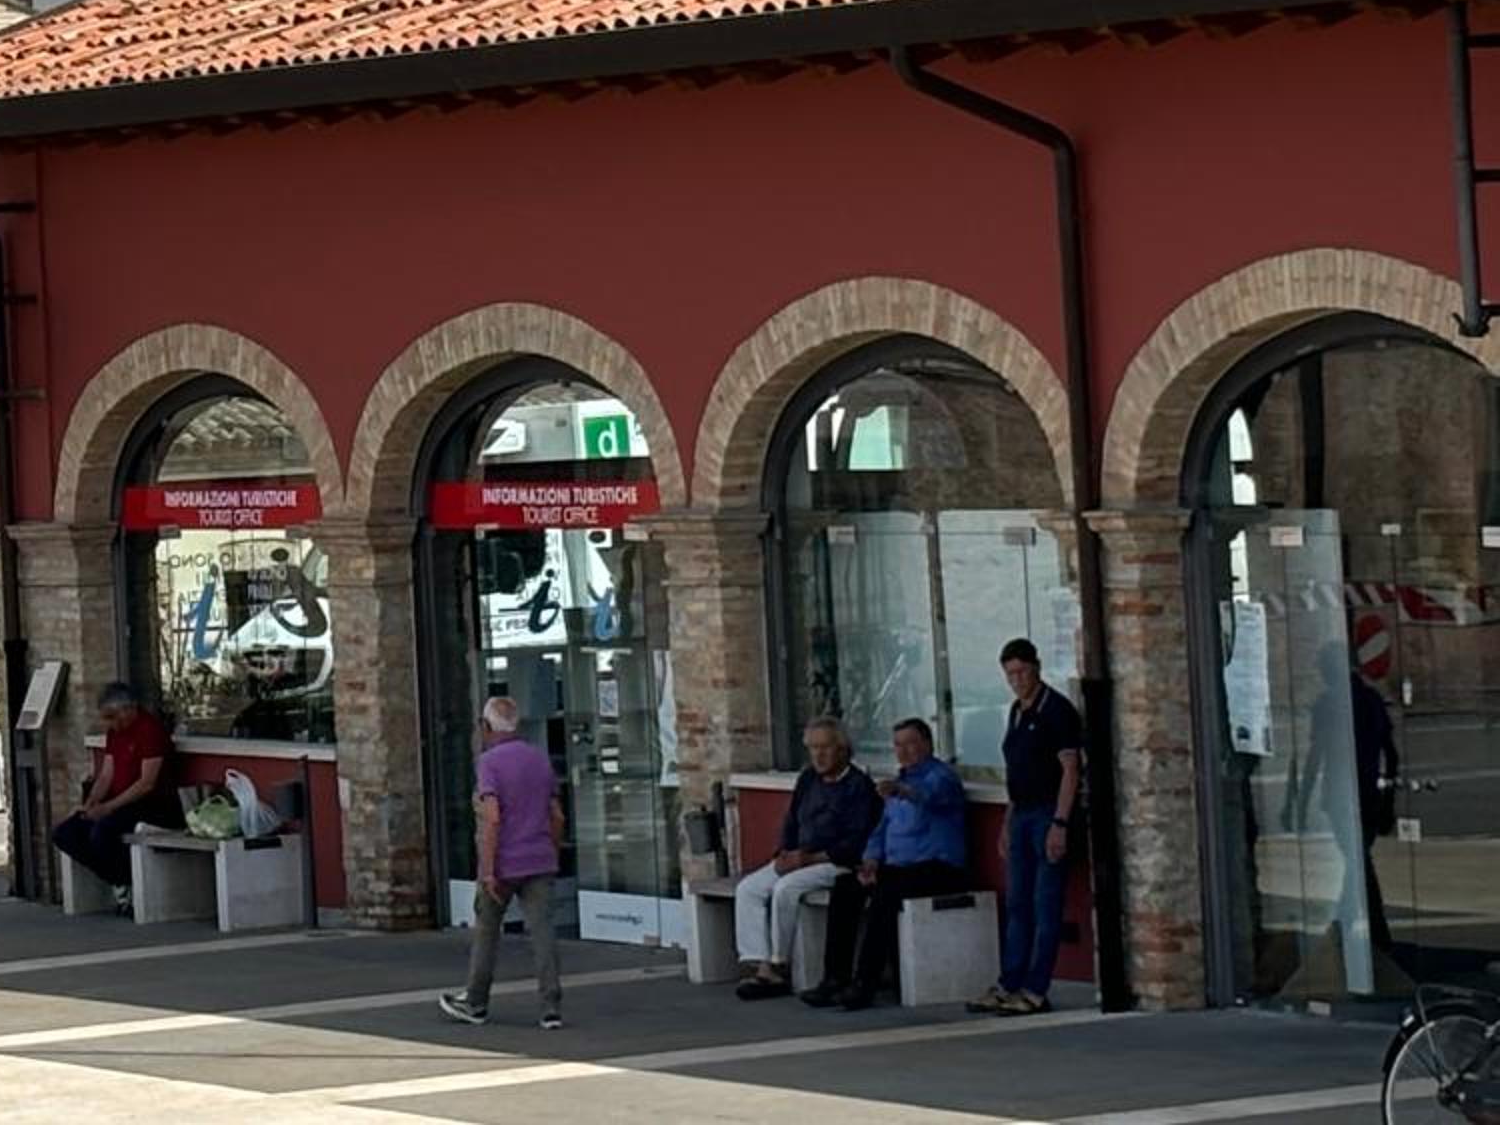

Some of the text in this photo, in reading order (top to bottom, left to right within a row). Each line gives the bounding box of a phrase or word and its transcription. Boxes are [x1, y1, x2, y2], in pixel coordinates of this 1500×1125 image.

[164, 489, 298, 509] INFORMAZIONI TURISTICHE
[482, 486, 638, 505] INFORMAZIONI TURISTICHE
[198, 508, 264, 525] TOURIST OFFICE
[522, 506, 599, 524] TOURIST OFFICE
